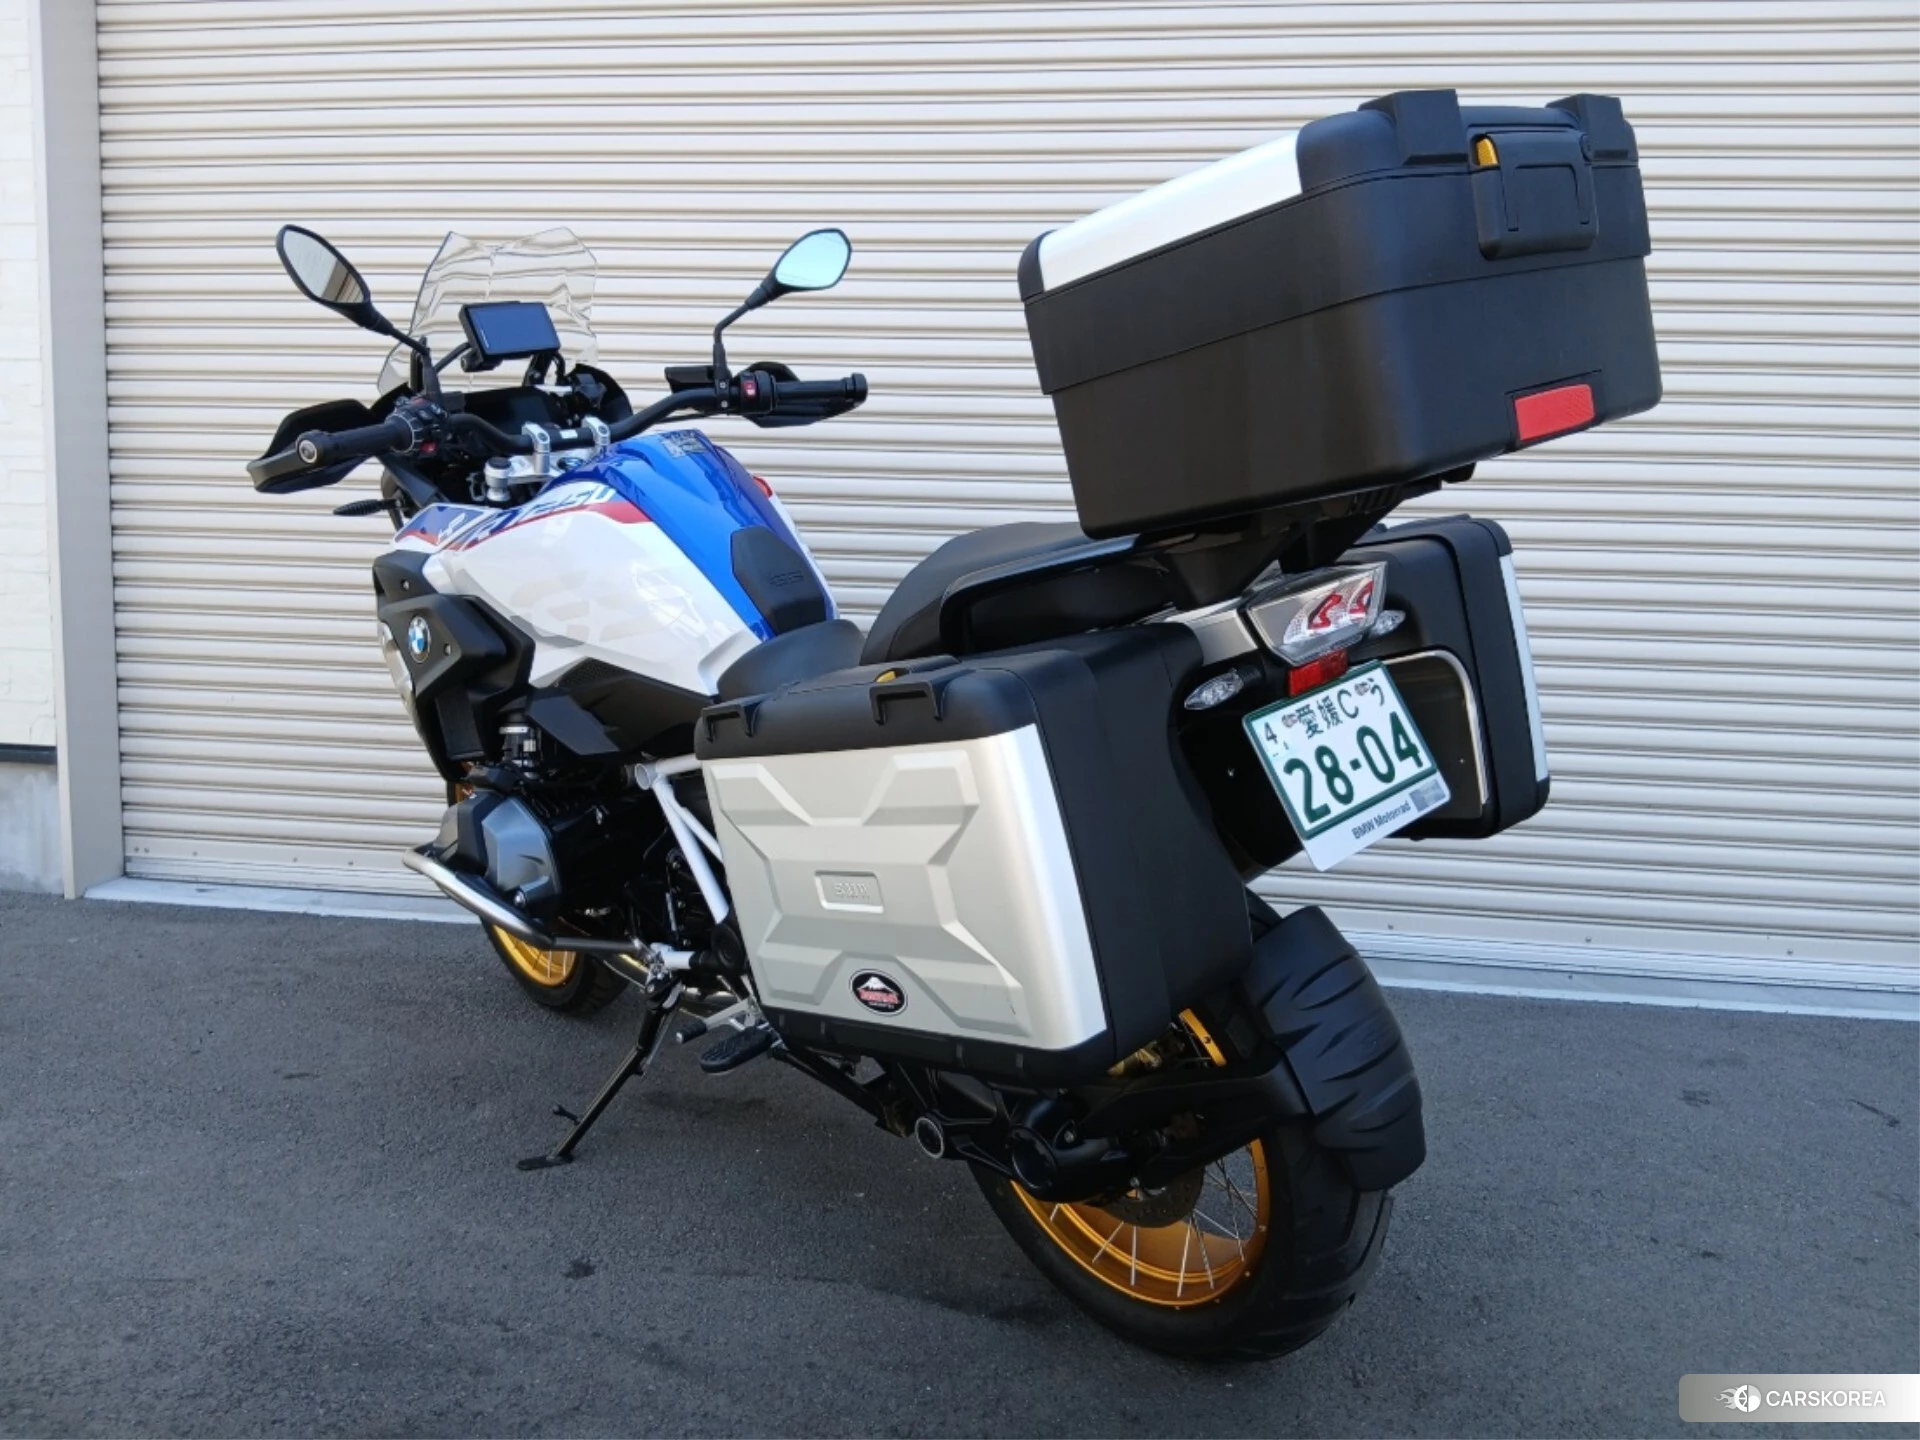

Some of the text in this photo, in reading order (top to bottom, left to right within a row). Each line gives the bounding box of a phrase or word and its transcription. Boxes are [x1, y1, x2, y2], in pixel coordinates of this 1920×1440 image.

[1283, 710, 1424, 824] 28-04
[1351, 799, 1411, 840] BMW Motorrad
